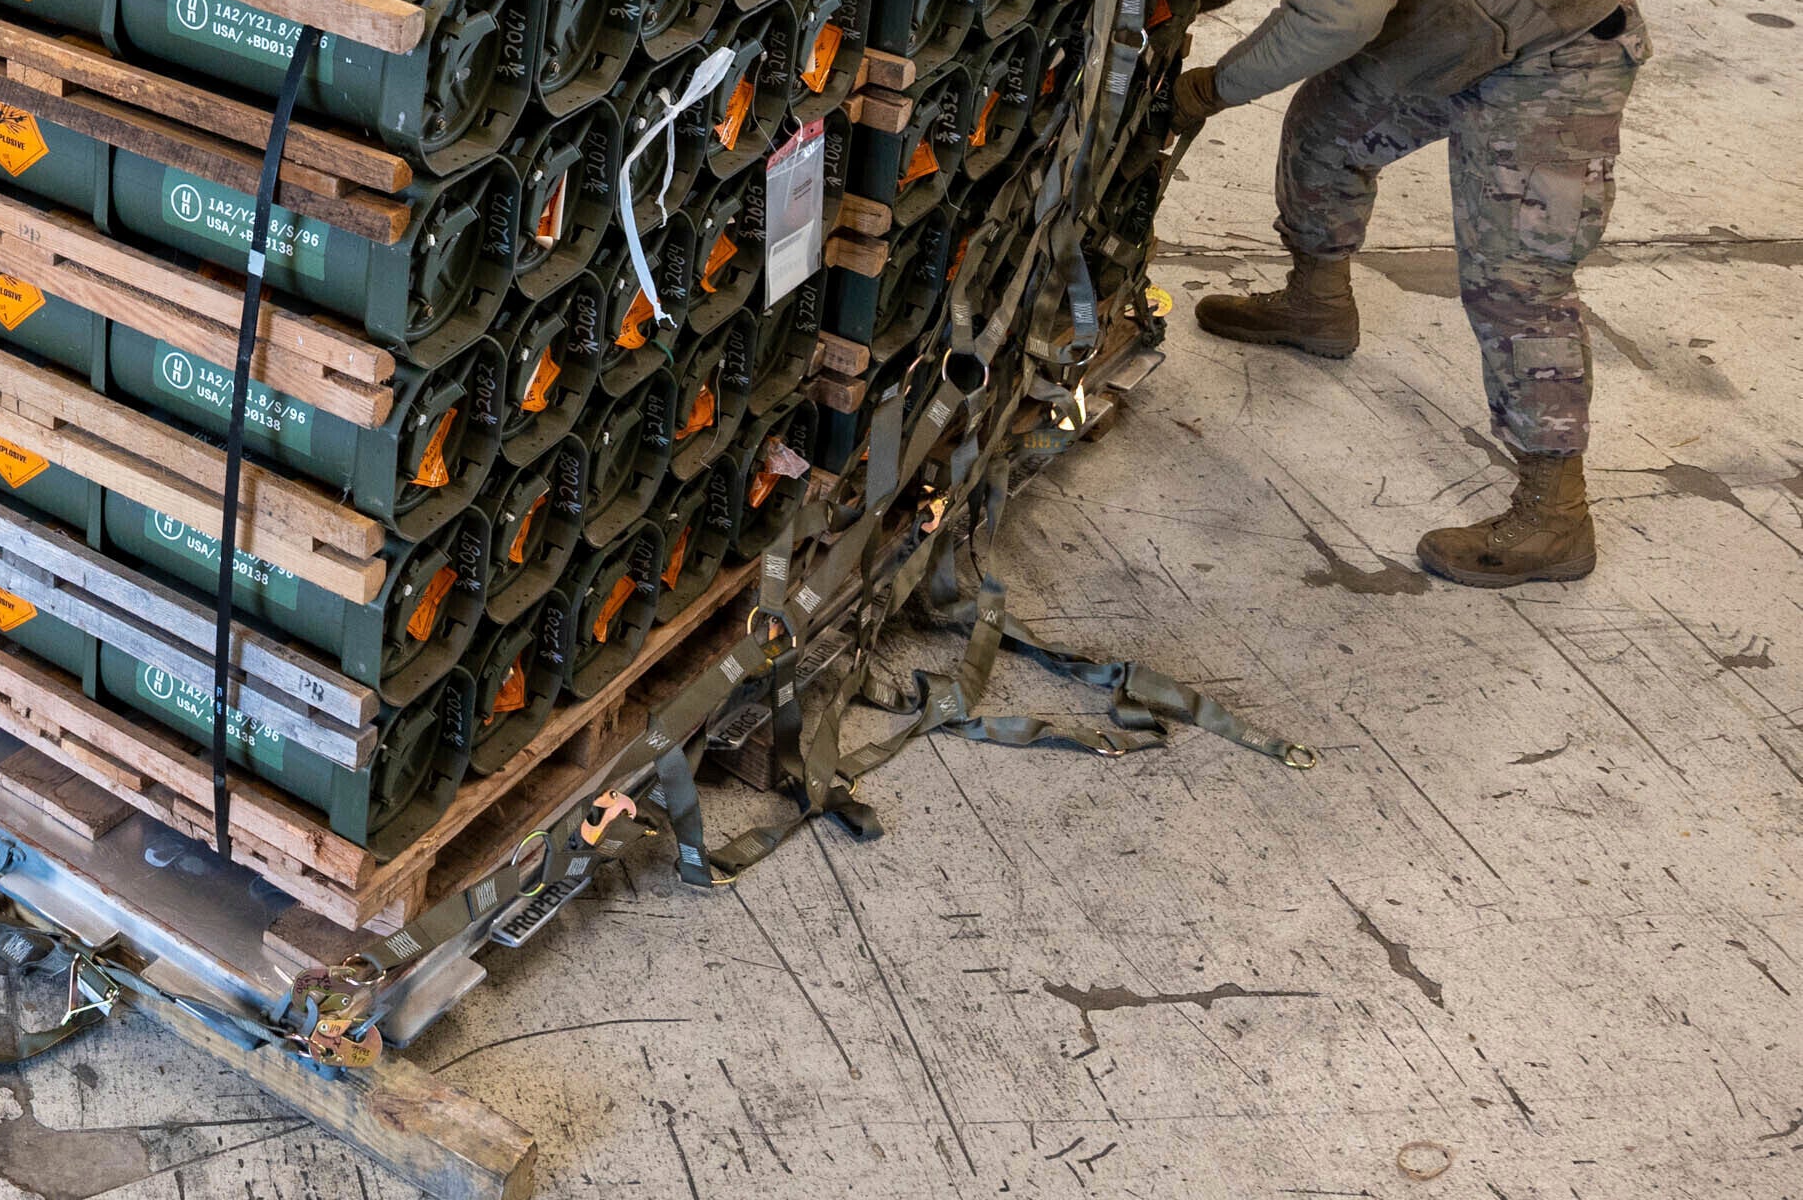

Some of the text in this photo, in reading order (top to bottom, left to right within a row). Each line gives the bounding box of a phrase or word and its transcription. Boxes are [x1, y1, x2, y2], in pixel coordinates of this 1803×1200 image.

[212, 21, 295, 59] USA/ +BD013
[214, 3, 329, 49] 1A2/Y21.8/S6
[504, 7, 527, 60] 2067
[768, 30, 789, 73] 2075
[207, 197, 320, 248] 1A2/Y28/S/96
[488, 192, 514, 243] 2072
[744, 182, 766, 231] 2085
[206, 214, 295, 257] USA/ +B0138
[665, 243, 686, 287] 2084
[575, 292, 597, 341] 2083
[196, 384, 227, 408] USA/
[475, 362, 496, 413] 2082
[558, 451, 580, 500] 2088
[186, 535, 216, 559] USA/
[460, 530, 481, 578] 2087
[543, 606, 565, 650] 2203
[176, 696, 205, 720] USA/
[446, 685, 463, 732] 2202
[719, 707, 759, 742] FORCE
[501, 877, 583, 939] PROPERT
